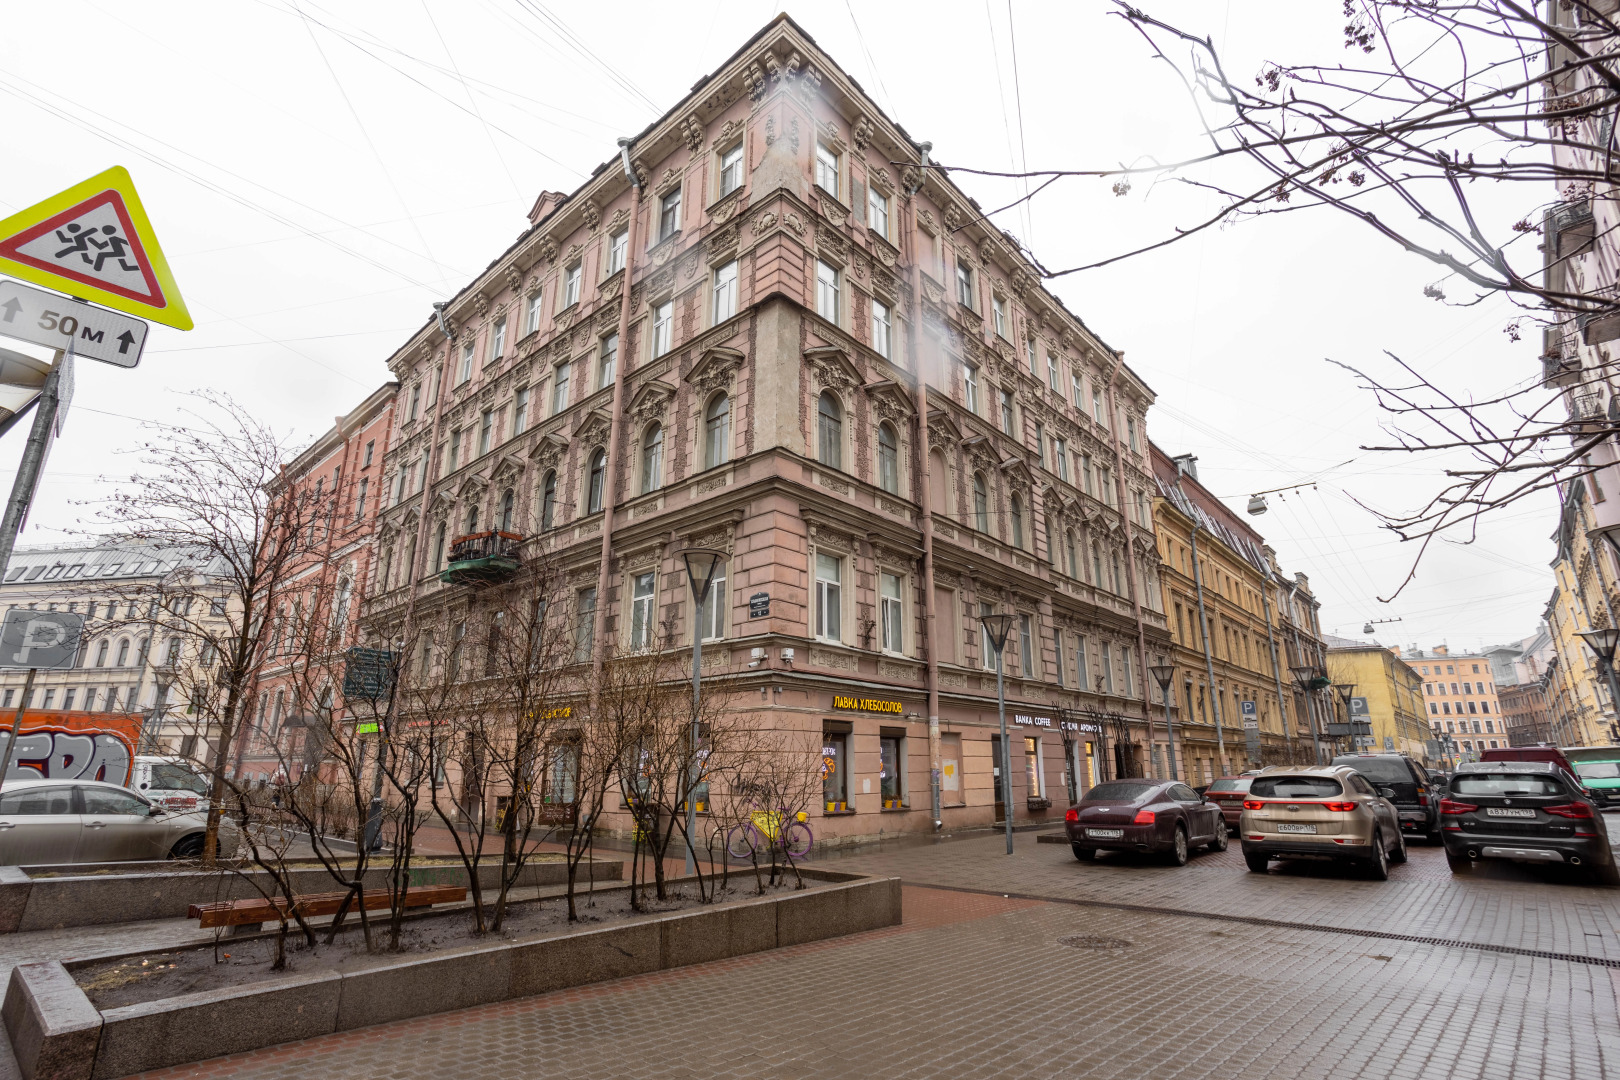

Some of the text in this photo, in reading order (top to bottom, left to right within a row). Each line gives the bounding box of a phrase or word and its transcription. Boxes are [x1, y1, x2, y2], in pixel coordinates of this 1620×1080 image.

[833, 695, 903, 713] ЛАВКА ХЛЕБОСОЛОВ
[1243, 702, 1253, 714] P
[1351, 699, 1363, 713] P
[1015, 714, 1051, 727] BANKA COFFEE
